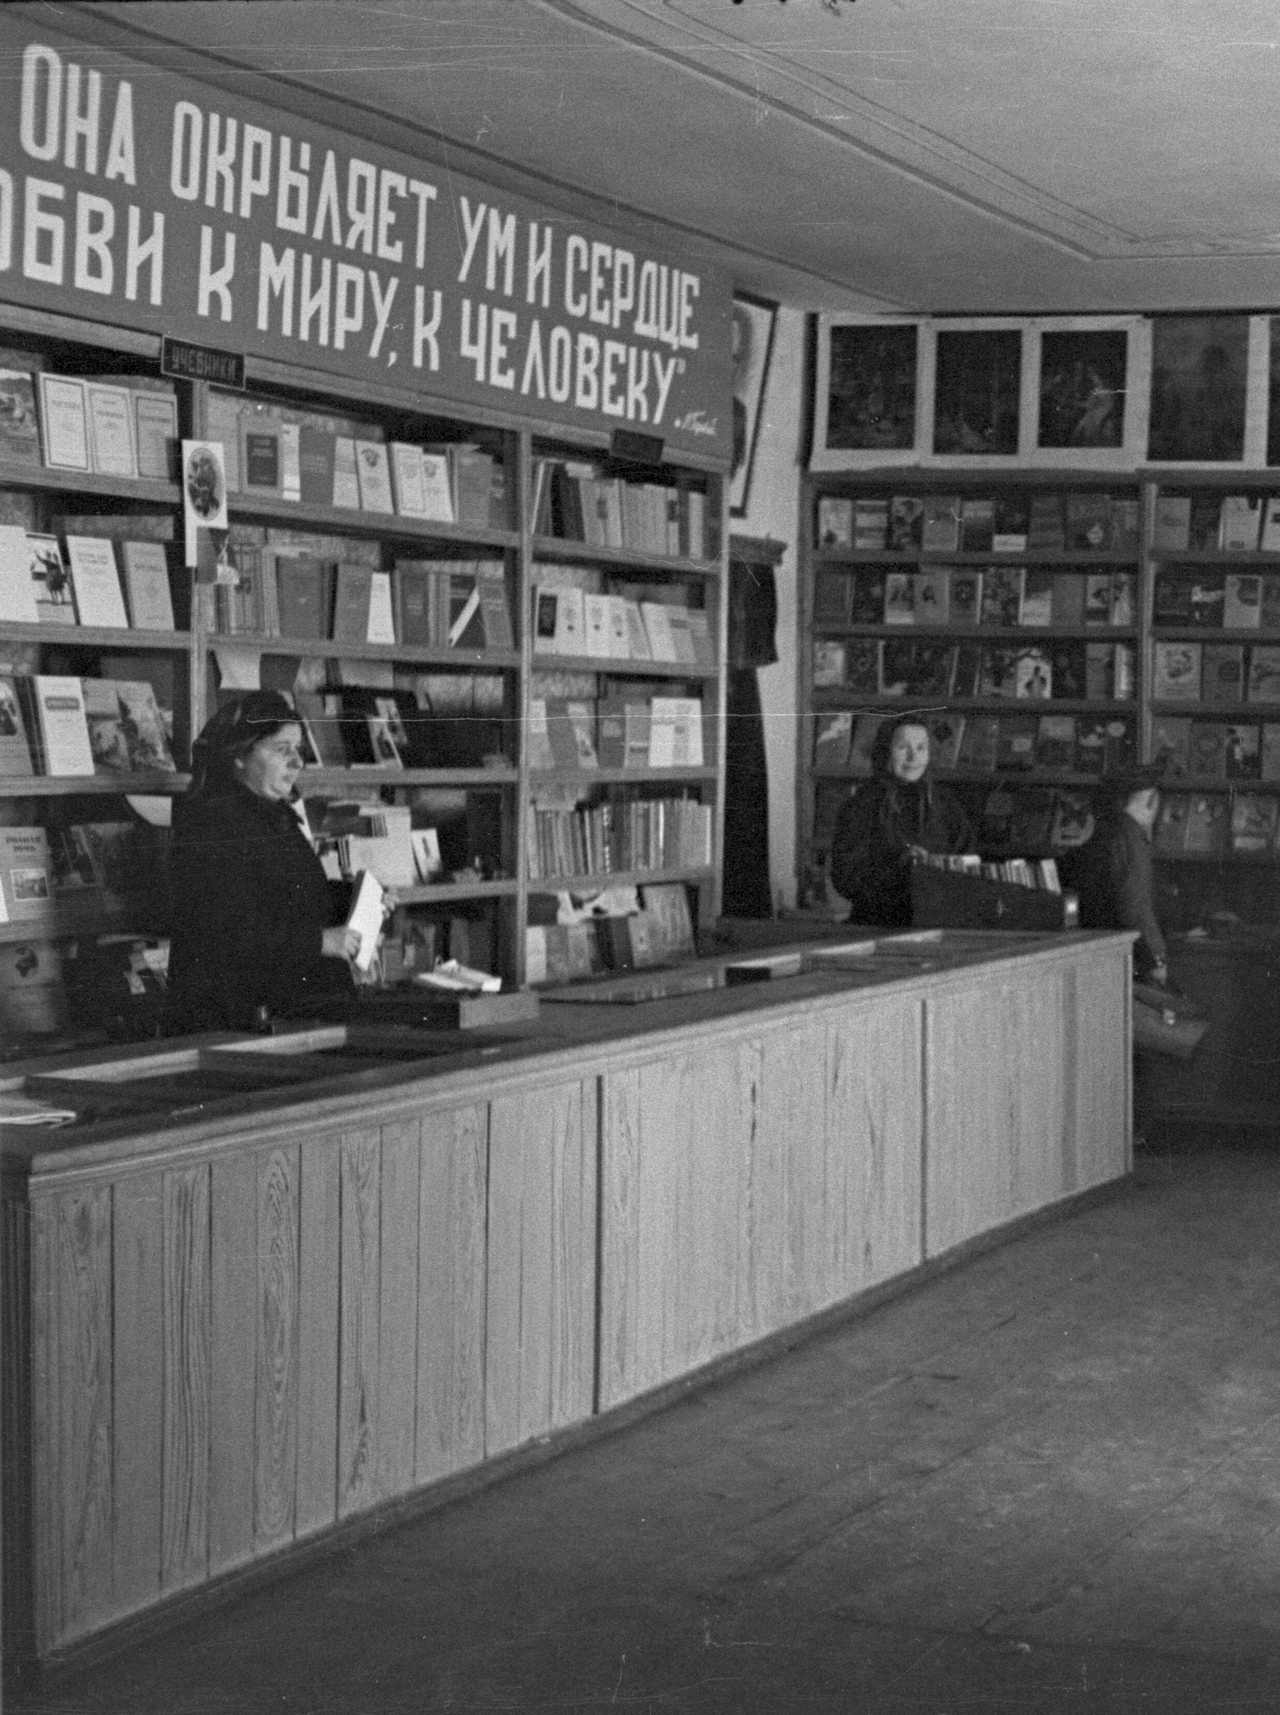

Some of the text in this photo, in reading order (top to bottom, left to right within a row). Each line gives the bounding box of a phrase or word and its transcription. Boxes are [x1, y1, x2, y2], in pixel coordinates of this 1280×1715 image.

[0, 168, 165, 306] БВИ
[196, 225, 237, 323] К
[256, 241, 398, 368] МИРУ,
[412, 285, 443, 380] К
[20, 44, 700, 352] ОНА ОКРЫЛЯЕТ УМ И СЕРДЦЕ
[173, 346, 237, 382] УЧЕБНИКИ
